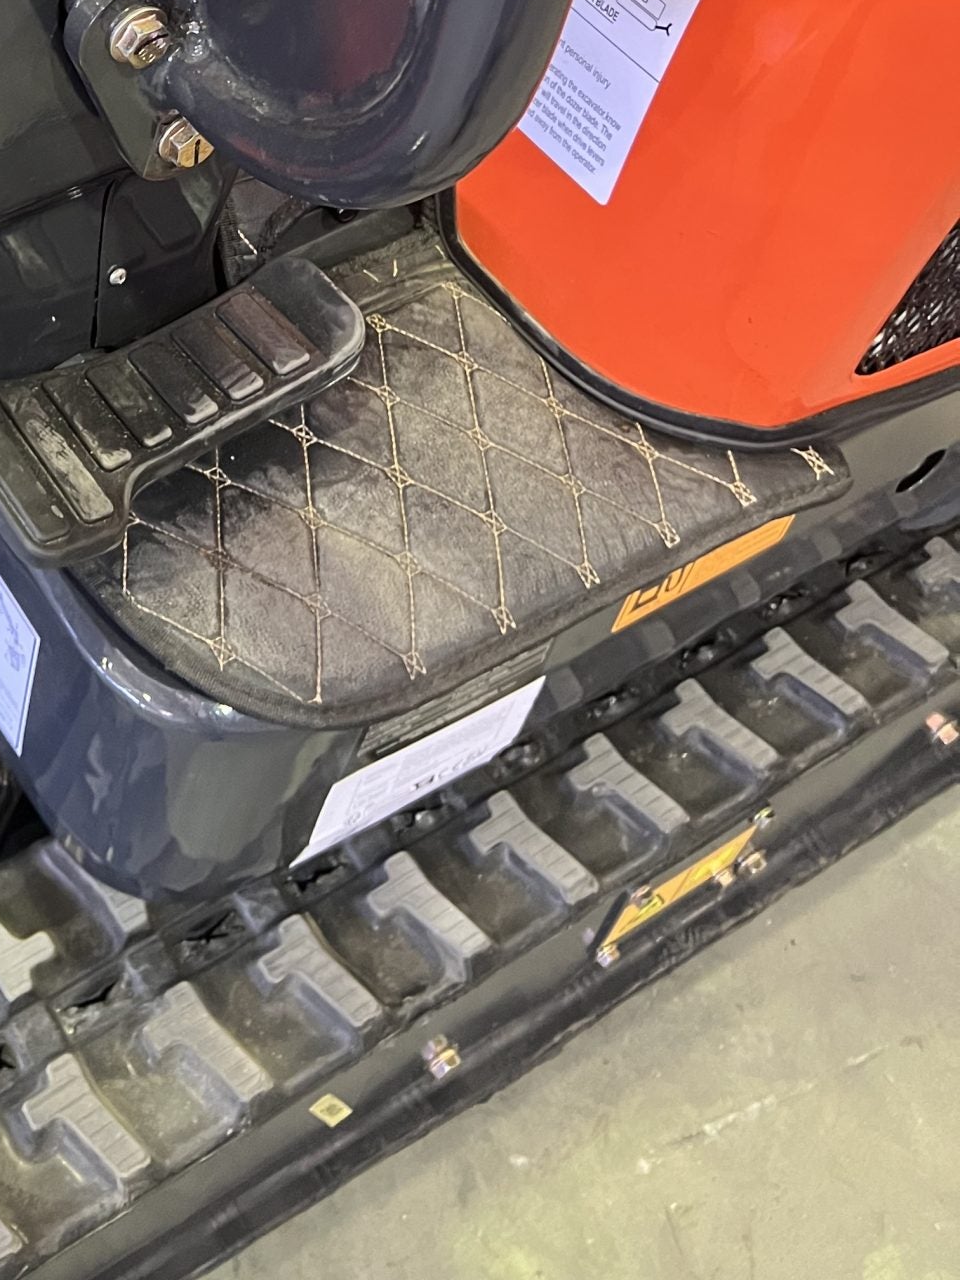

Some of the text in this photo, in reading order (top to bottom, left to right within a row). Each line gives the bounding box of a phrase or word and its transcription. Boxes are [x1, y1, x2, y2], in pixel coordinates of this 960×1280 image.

[565, 45, 593, 73] personal
[592, 65, 611, 90] injury
[568, 80, 578, 93] the
[534, 114, 549, 132] away
[549, 126, 562, 143] from
[561, 138, 571, 152] the
[541, 104, 558, 123] blade
[557, 121, 573, 138] when
[572, 134, 587, 151] drive
[587, 145, 605, 167] levers
[550, 81, 558, 90] of
[556, 86, 566, 99] the
[566, 96, 583, 113] dozer
[601, 124, 613, 141] The
[550, 96, 567, 115] travel
[572, 117, 582, 130] the
[582, 126, 606, 152] direction
